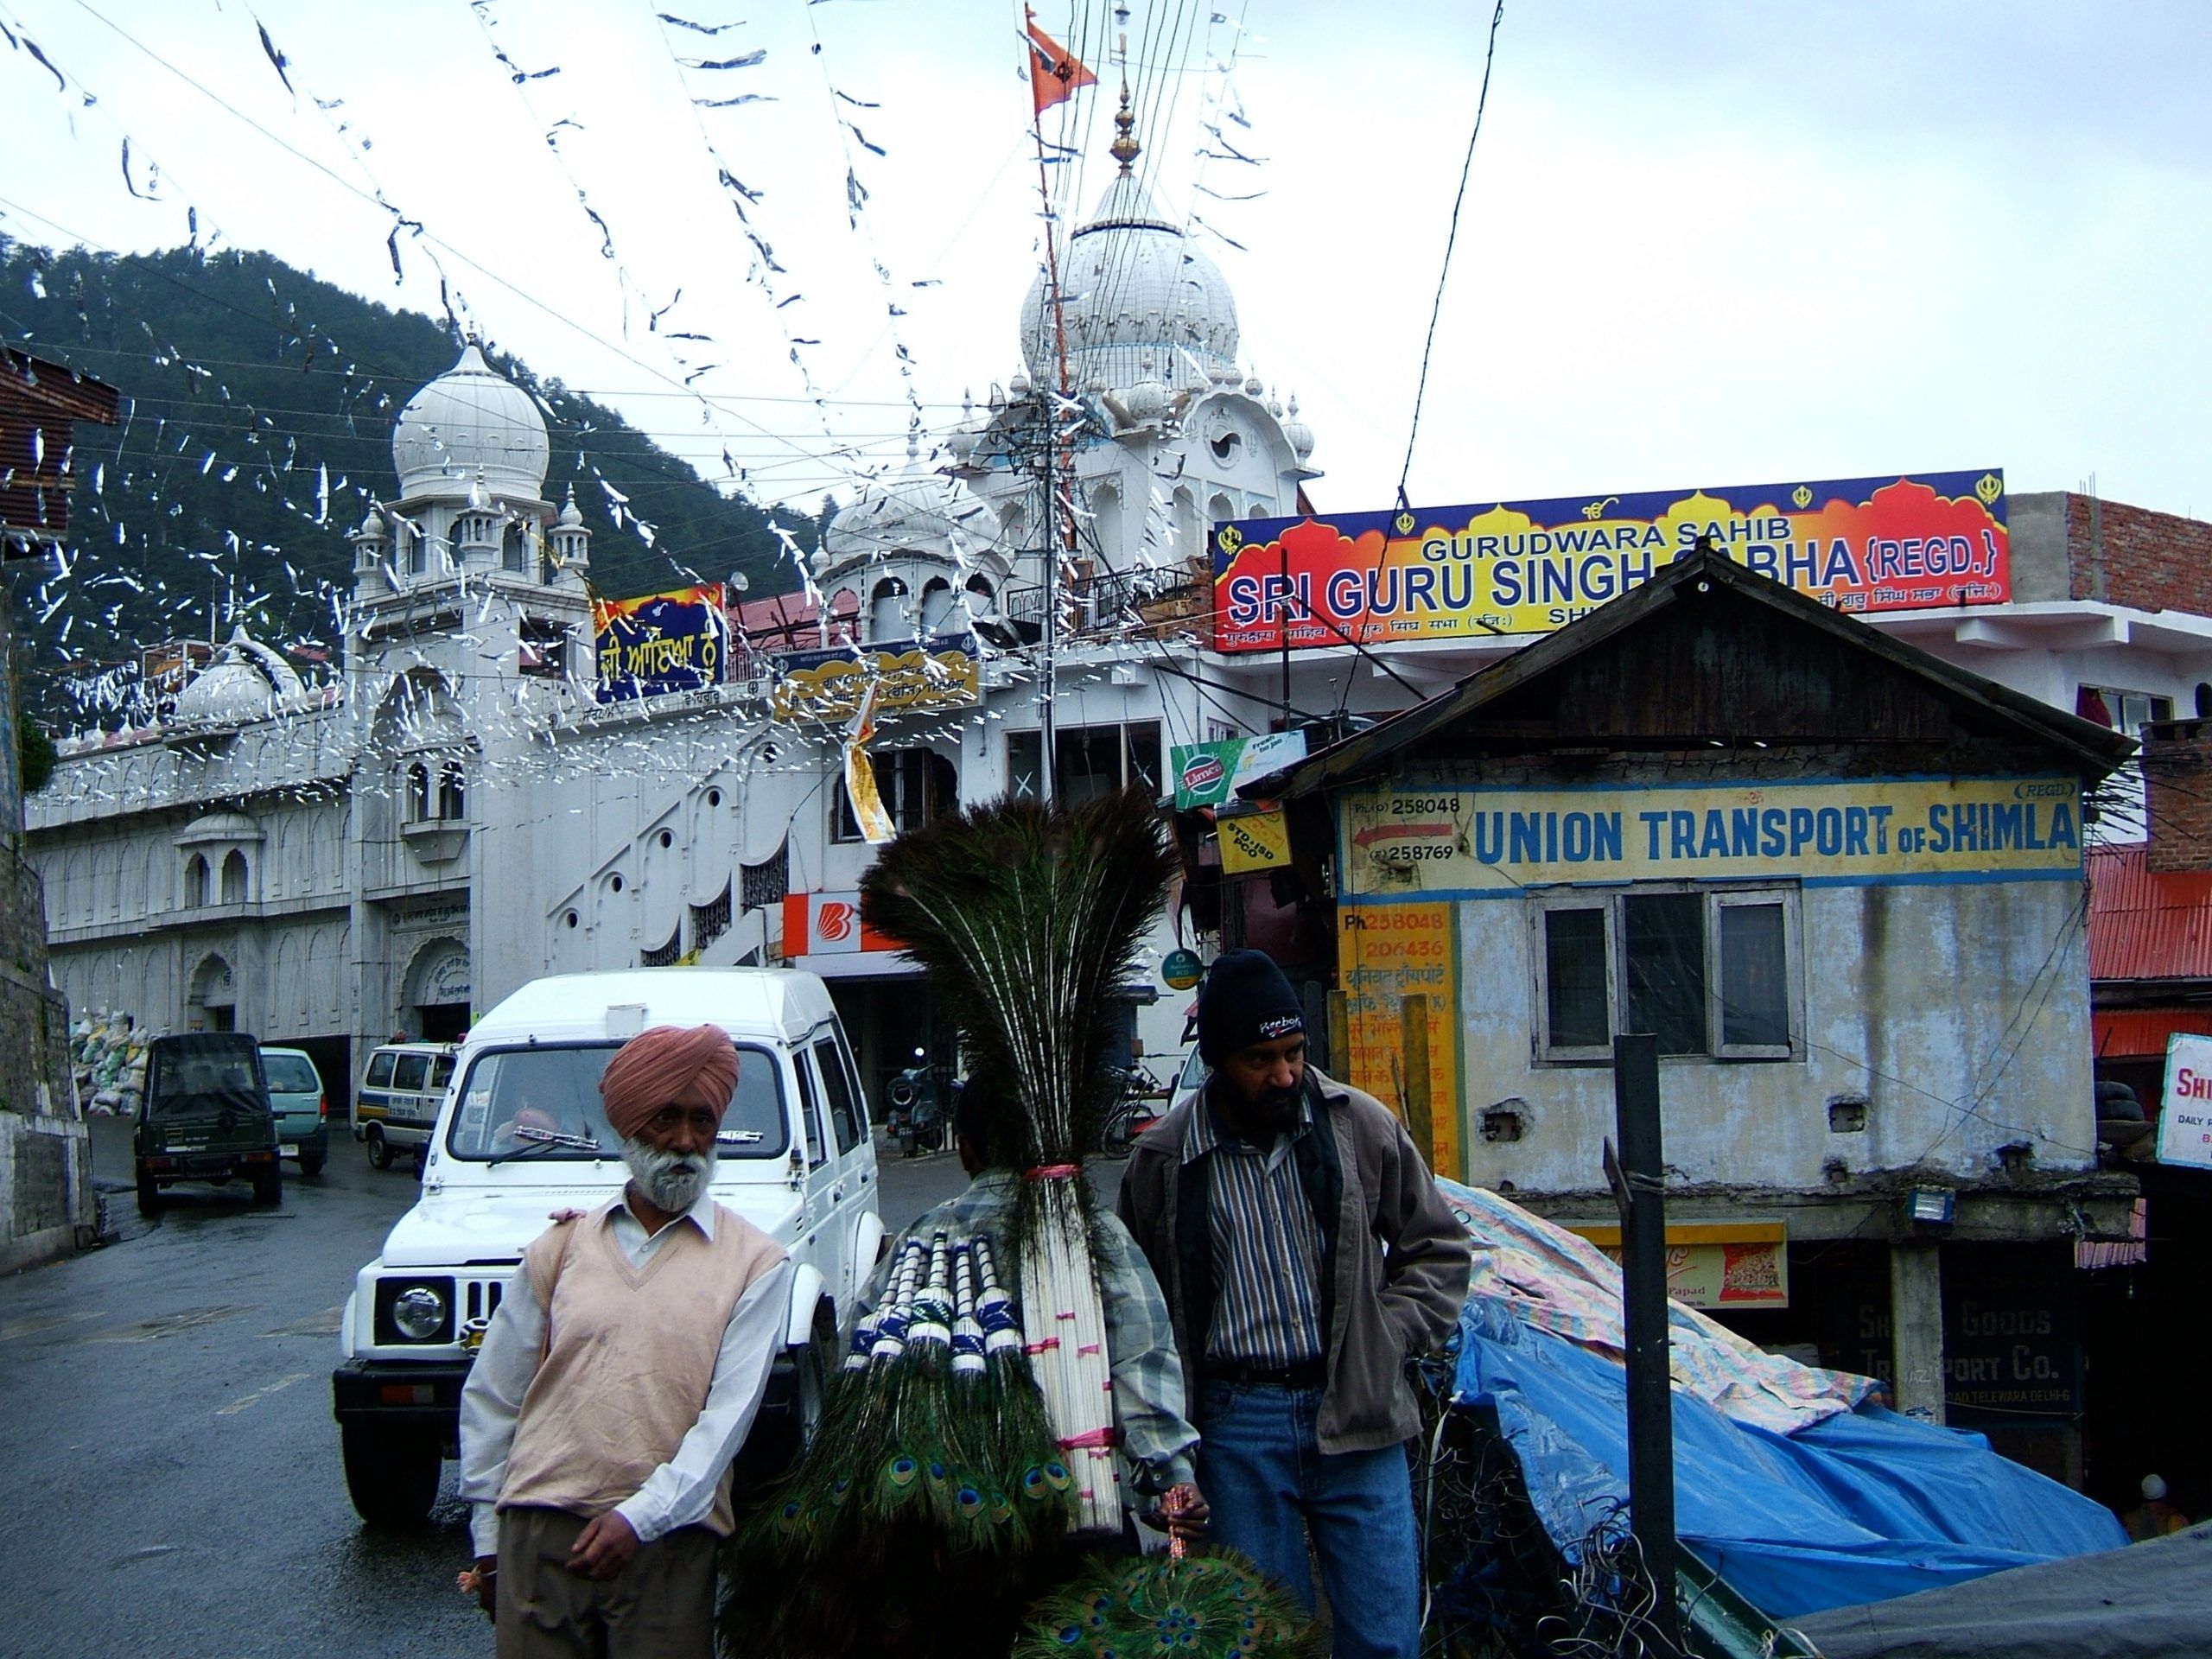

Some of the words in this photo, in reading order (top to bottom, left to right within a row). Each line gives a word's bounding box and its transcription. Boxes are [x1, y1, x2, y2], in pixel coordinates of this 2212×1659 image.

[1422, 524, 1667, 563] GURUDWARA
[1676, 517, 1792, 544] SAHIB
[1229, 570, 1312, 624] SRI
[1326, 562, 1474, 618] GURU
[1491, 552, 1652, 607] SINGH
[1673, 537, 1860, 588] BHA
[1865, 529, 1998, 584] {REGD.}
[1185, 761, 1223, 787] Limca
[1392, 798, 1460, 815] 258048
[1474, 810, 1623, 865] UNION
[1639, 804, 1893, 861] TRANSPORT
[1897, 826, 1926, 854] OF
[1929, 802, 2079, 854] SHIMLA
[1233, 837, 1258, 858] PCO
[1389, 845, 1453, 861] 258769
[2178, 1114, 2203, 1126] DAILY
[1668, 1286, 1706, 1297] Papad
